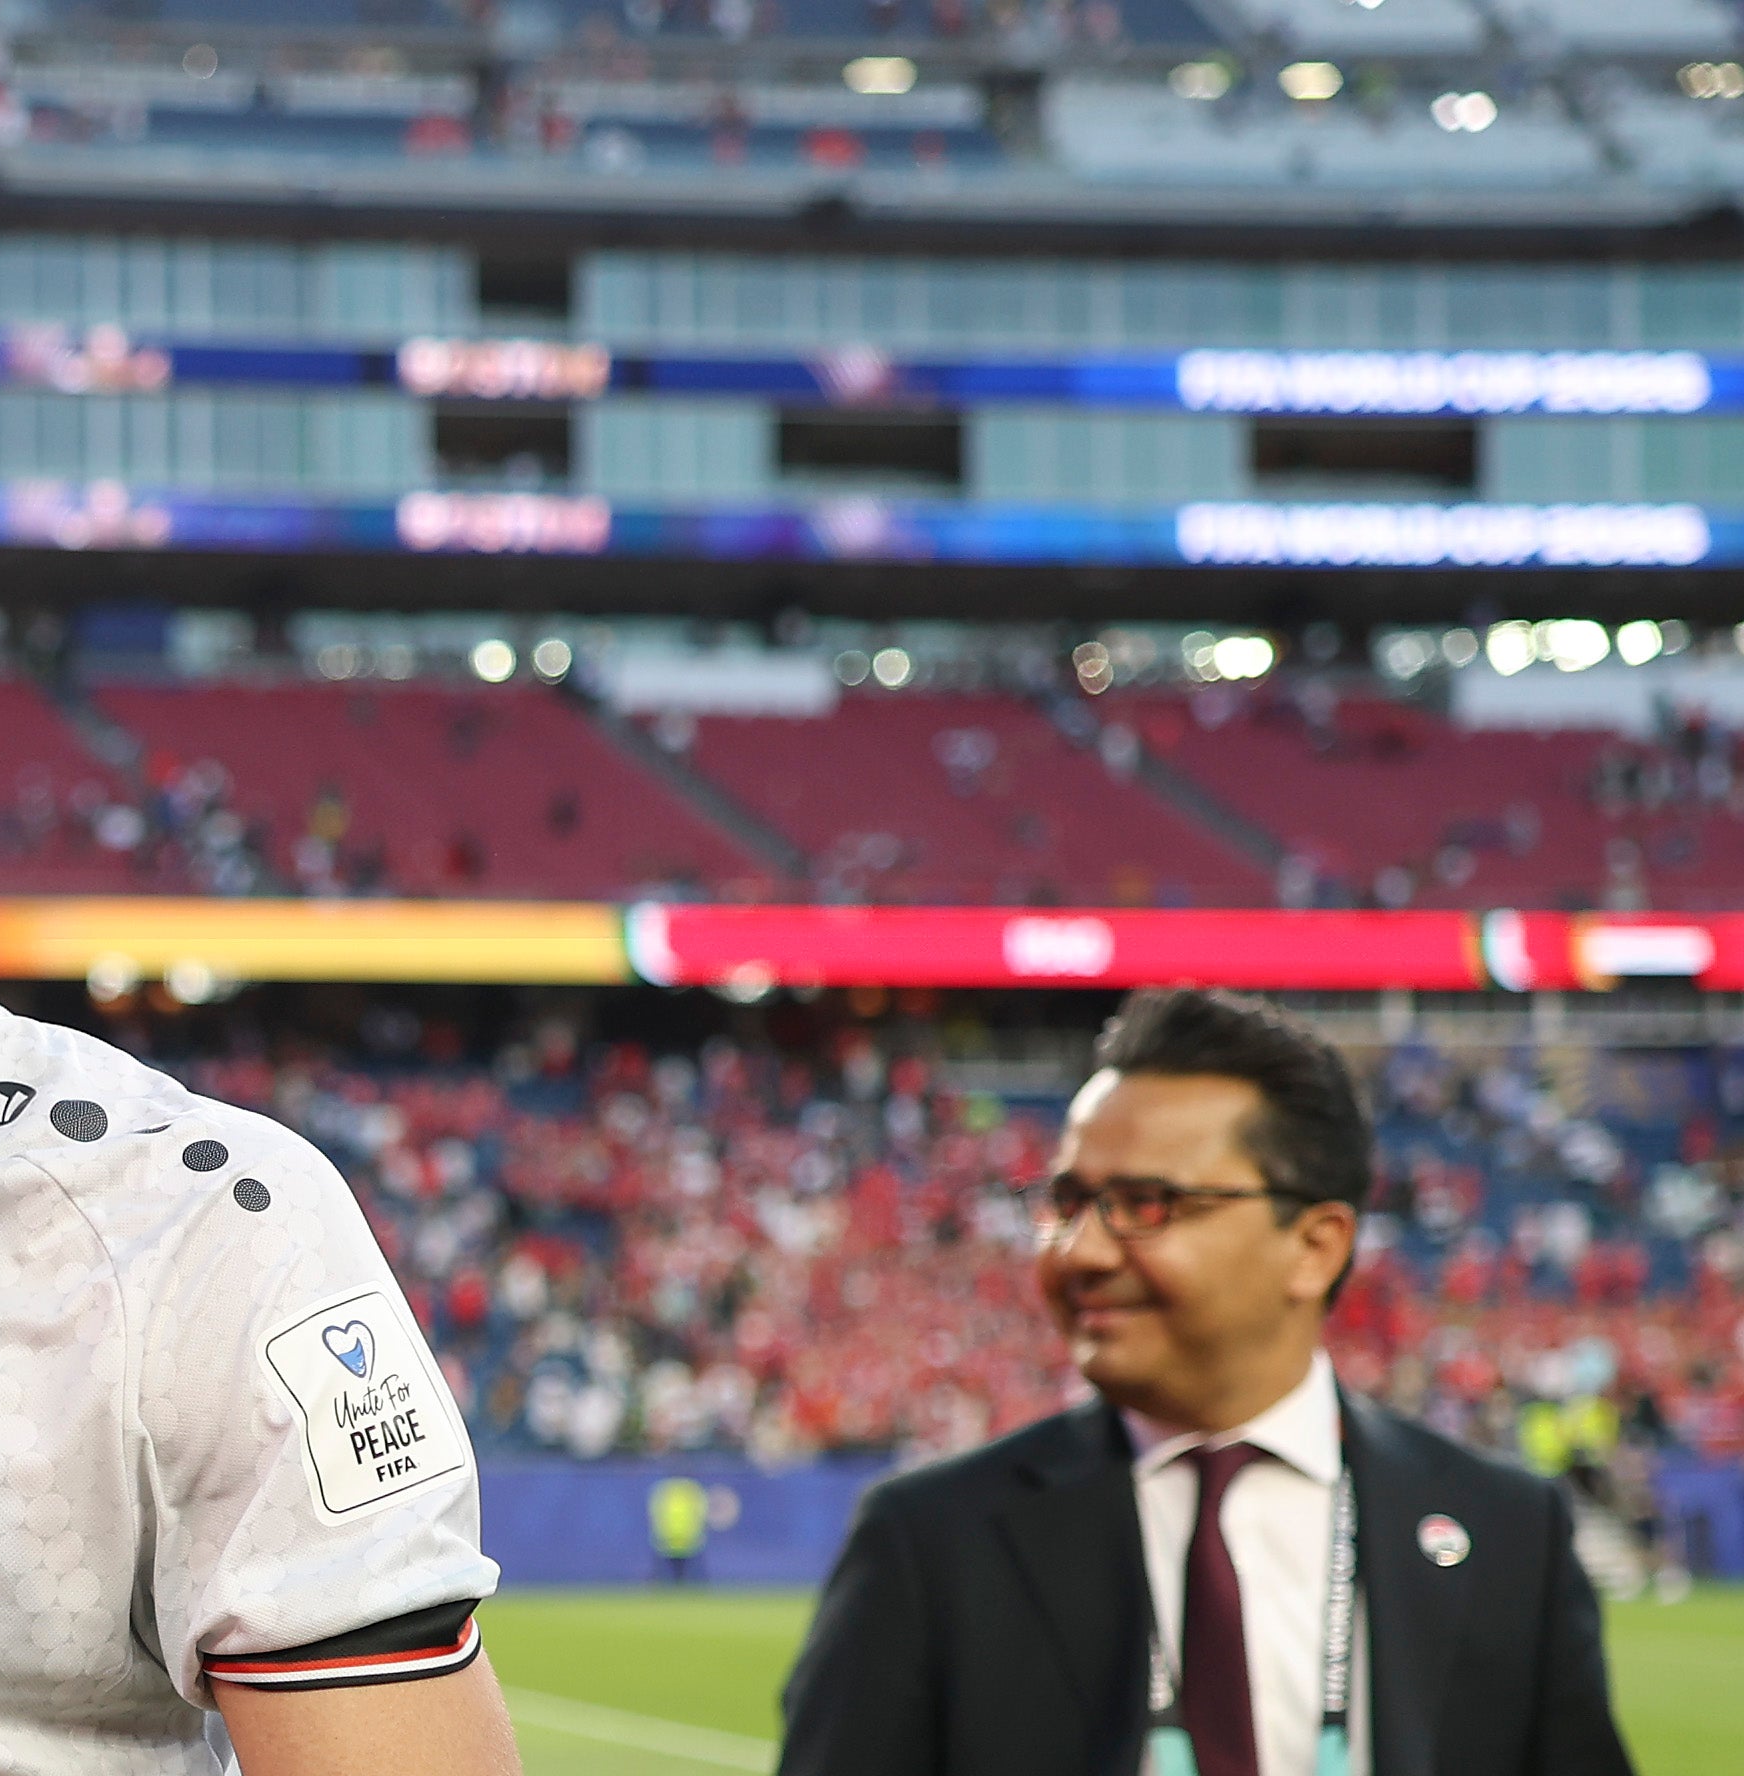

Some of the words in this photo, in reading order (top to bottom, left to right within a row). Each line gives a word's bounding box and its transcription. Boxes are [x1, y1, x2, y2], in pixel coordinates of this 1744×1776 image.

[333, 1387, 384, 1429] Unite
[379, 1374, 413, 1411] For
[350, 1408, 426, 1465] PEACE
[375, 1455, 418, 1484] FIFA
